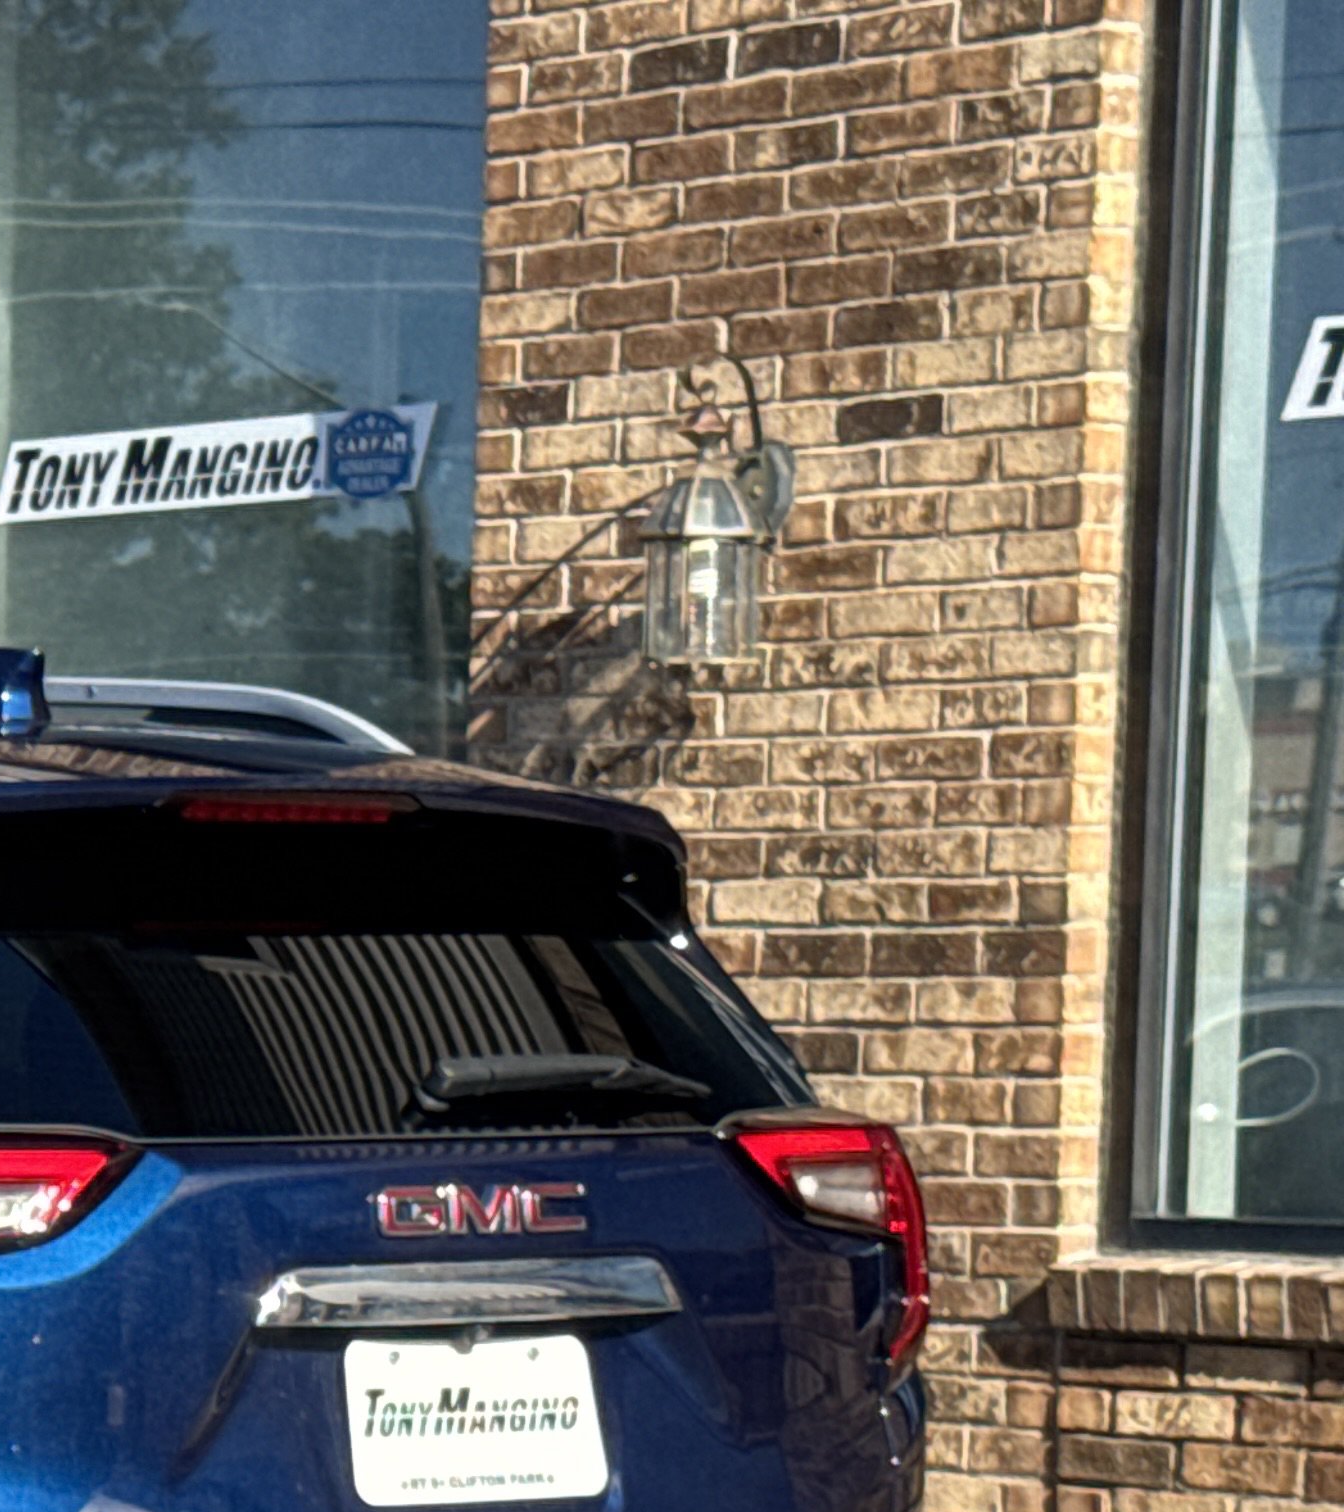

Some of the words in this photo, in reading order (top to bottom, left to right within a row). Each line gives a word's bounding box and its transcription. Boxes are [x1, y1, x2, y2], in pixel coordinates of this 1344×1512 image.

[7, 448, 117, 513] TONY
[376, 1182, 587, 1237] GMC
[364, 1388, 433, 1437] TONY
[434, 1387, 579, 1435] MANGINO
[449, 1475, 506, 1489] CLIFTON
[510, 1473, 545, 1485] PARK
